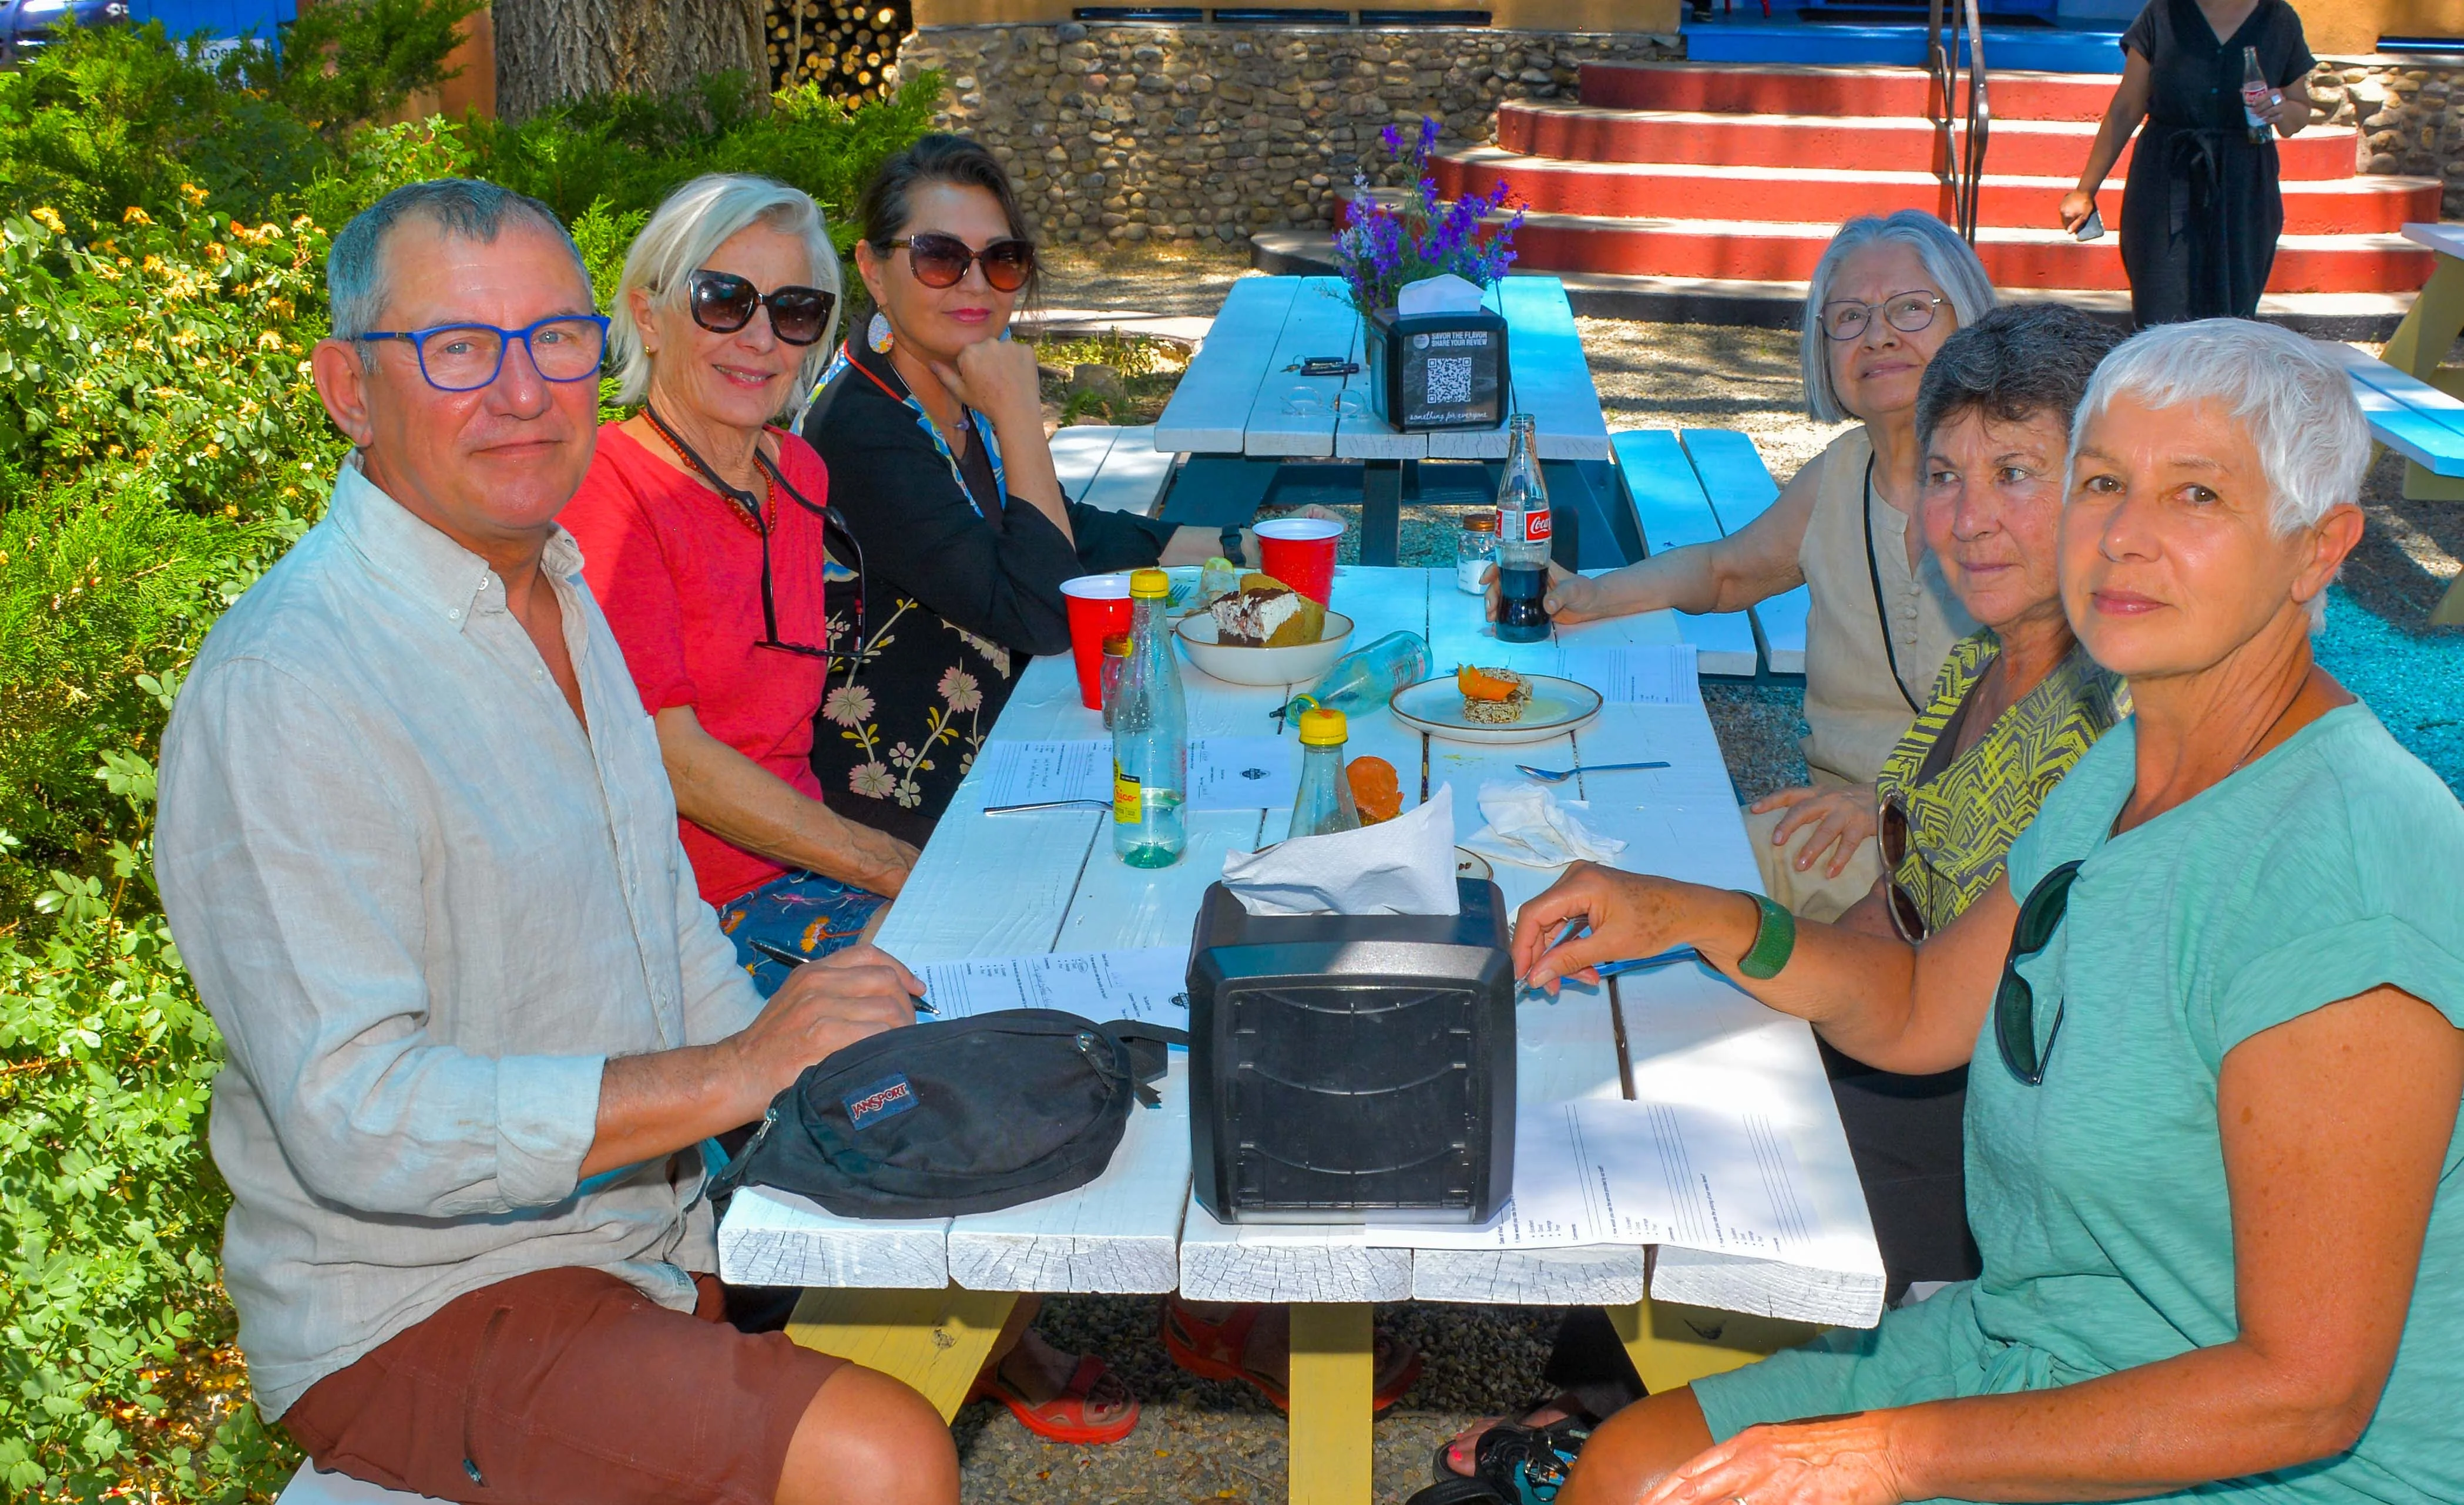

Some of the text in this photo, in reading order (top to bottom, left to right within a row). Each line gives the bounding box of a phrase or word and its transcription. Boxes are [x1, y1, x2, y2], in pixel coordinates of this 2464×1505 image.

[1409, 411, 1444, 422] something
[1445, 411, 1455, 422] for
[851, 1082, 908, 1120] JANSPORT
